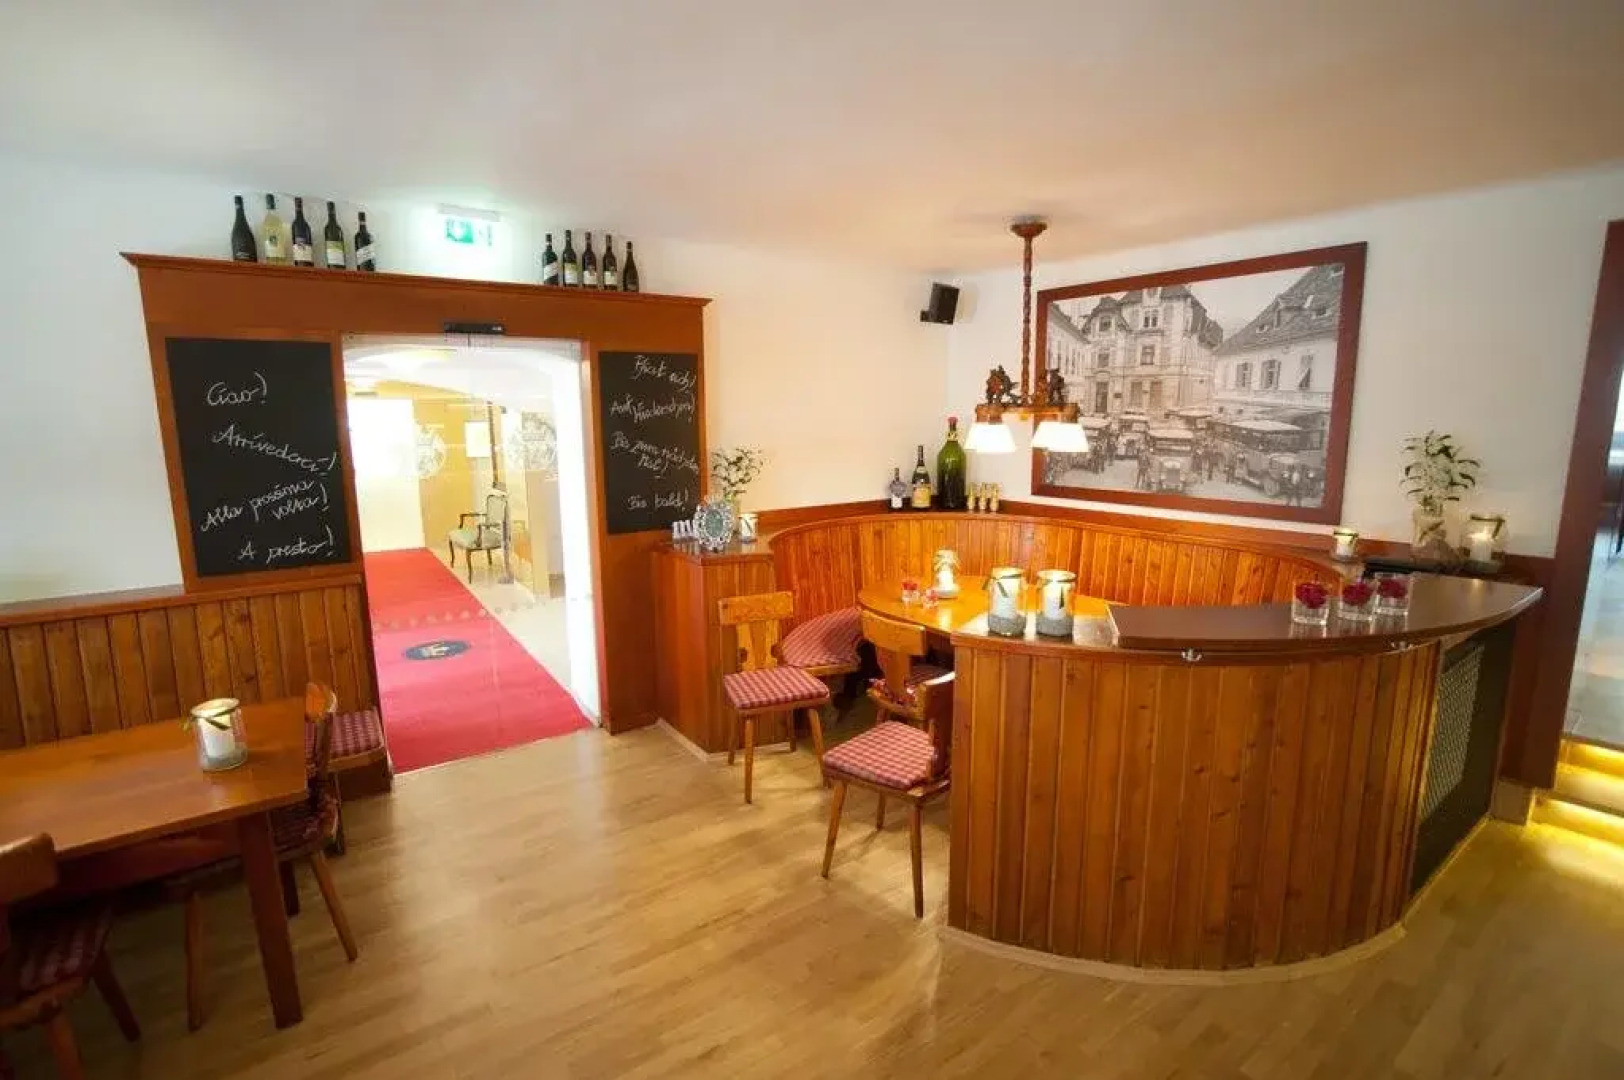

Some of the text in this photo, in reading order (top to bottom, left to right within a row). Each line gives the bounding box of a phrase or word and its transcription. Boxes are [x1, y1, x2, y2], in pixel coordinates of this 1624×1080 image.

[207, 372, 268, 406] Ciao!
[272, 483, 331, 520] volta!
[654, 487, 689, 513] bald!
[200, 505, 244, 532] Alla
[238, 524, 336, 565] A presto!
